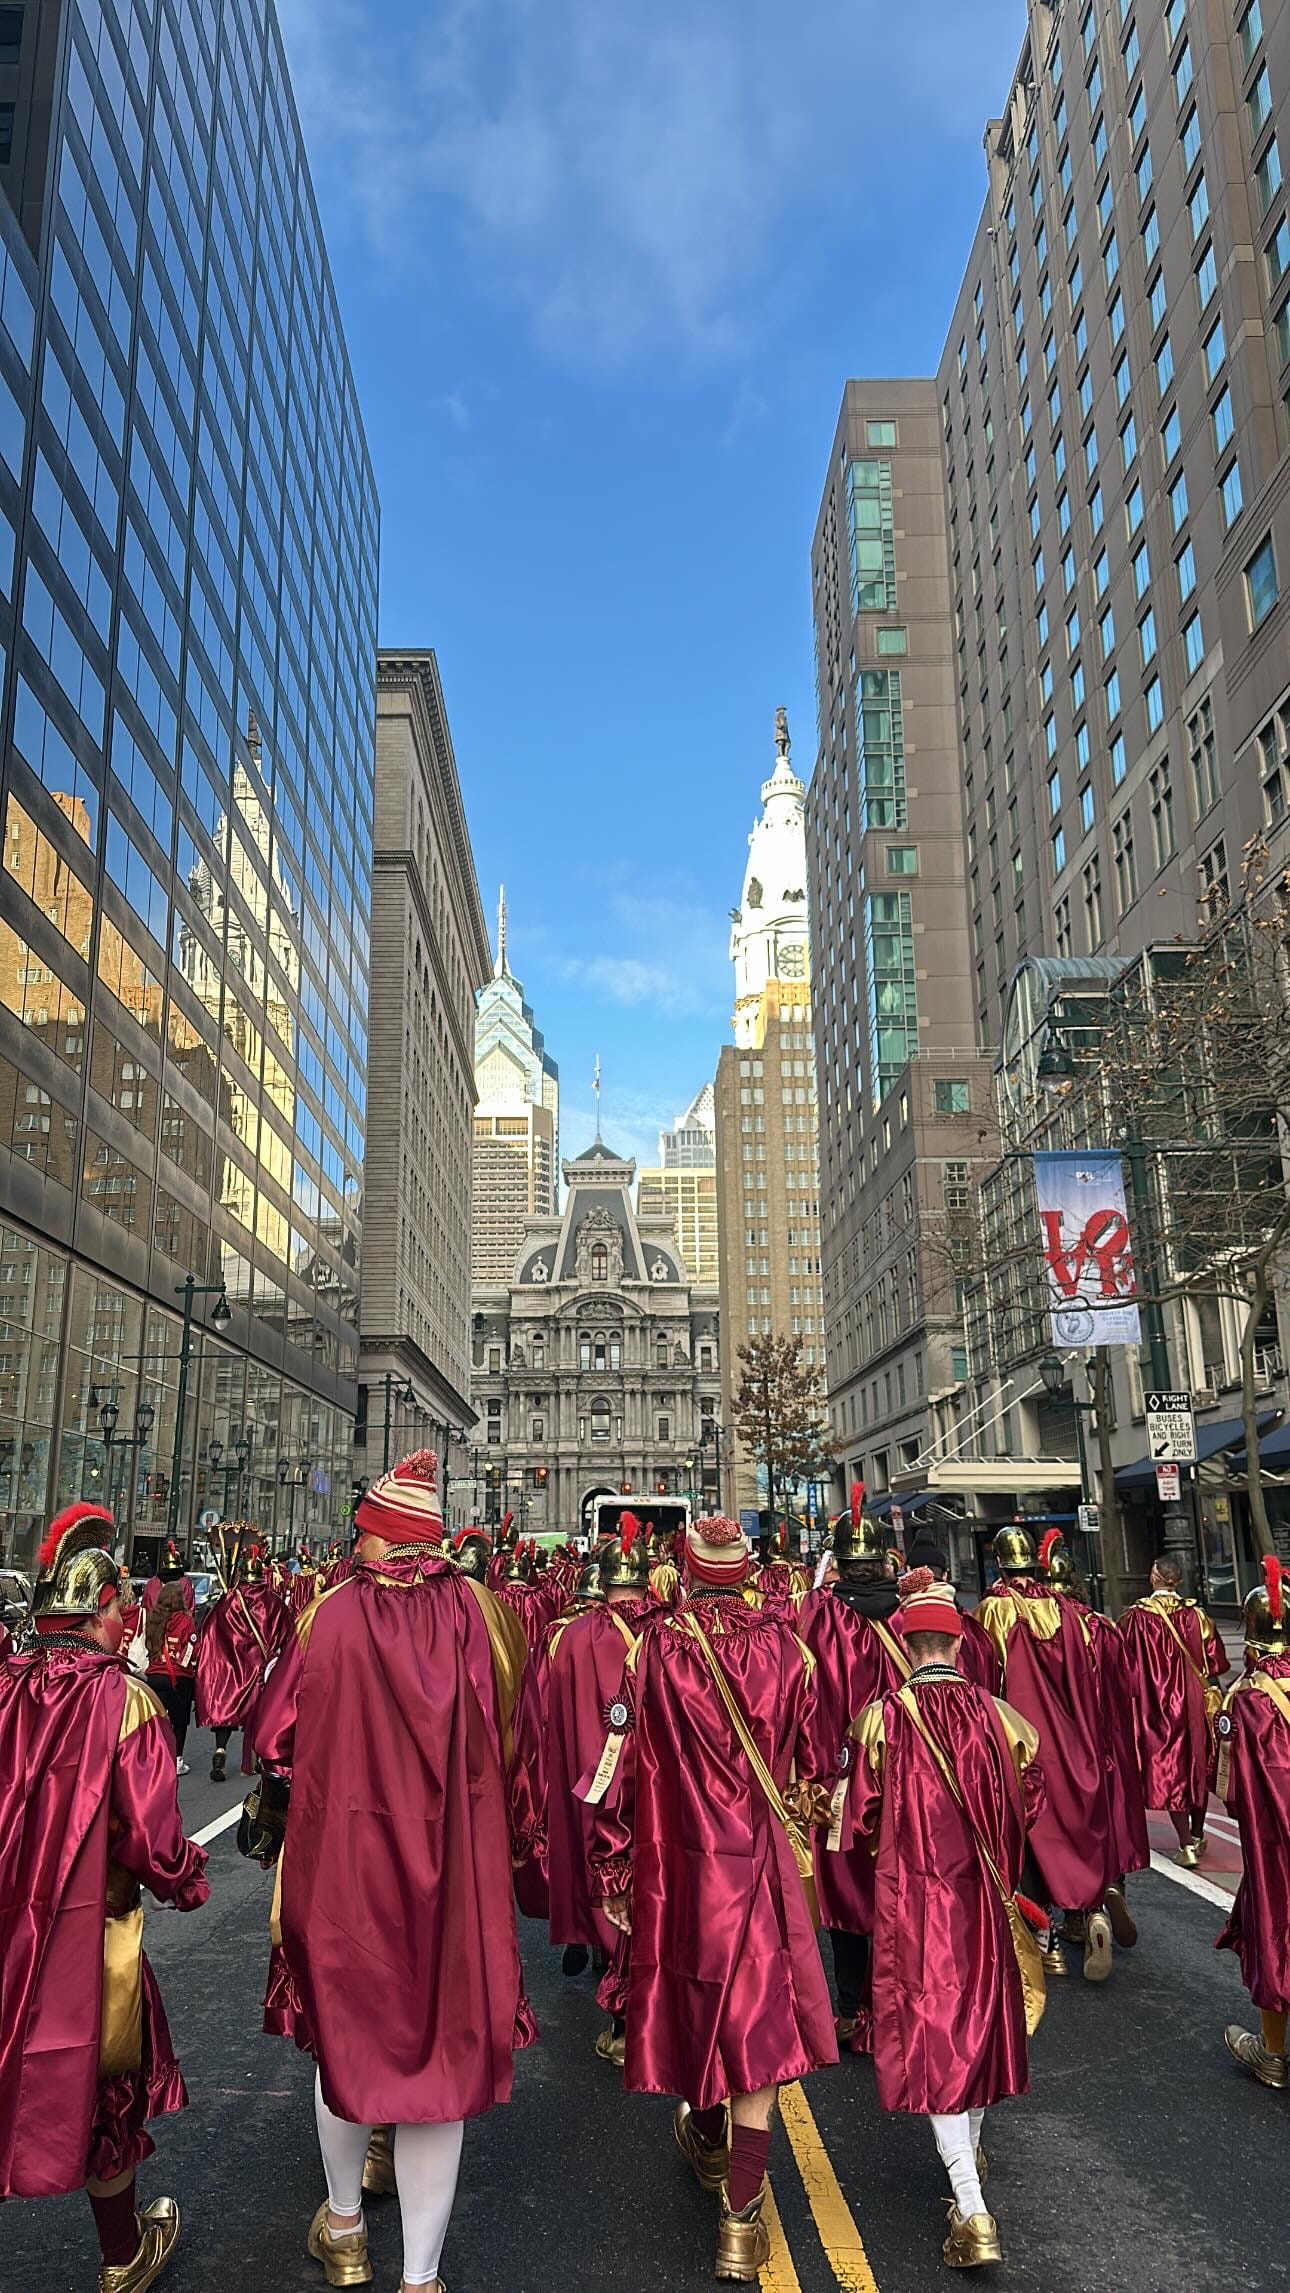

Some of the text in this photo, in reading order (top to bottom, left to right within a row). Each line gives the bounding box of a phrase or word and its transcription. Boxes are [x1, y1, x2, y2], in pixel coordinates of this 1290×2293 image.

[1162, 1394, 1188, 1402] RIGHT
[1165, 1402, 1189, 1410] LANE
[1156, 1414, 1183, 1422] BUSES
[1149, 1423, 1191, 1431] BICYCLES
[1152, 1431, 1190, 1440] AND RIGHT
[1173, 1449, 1192, 1457] ONLY
